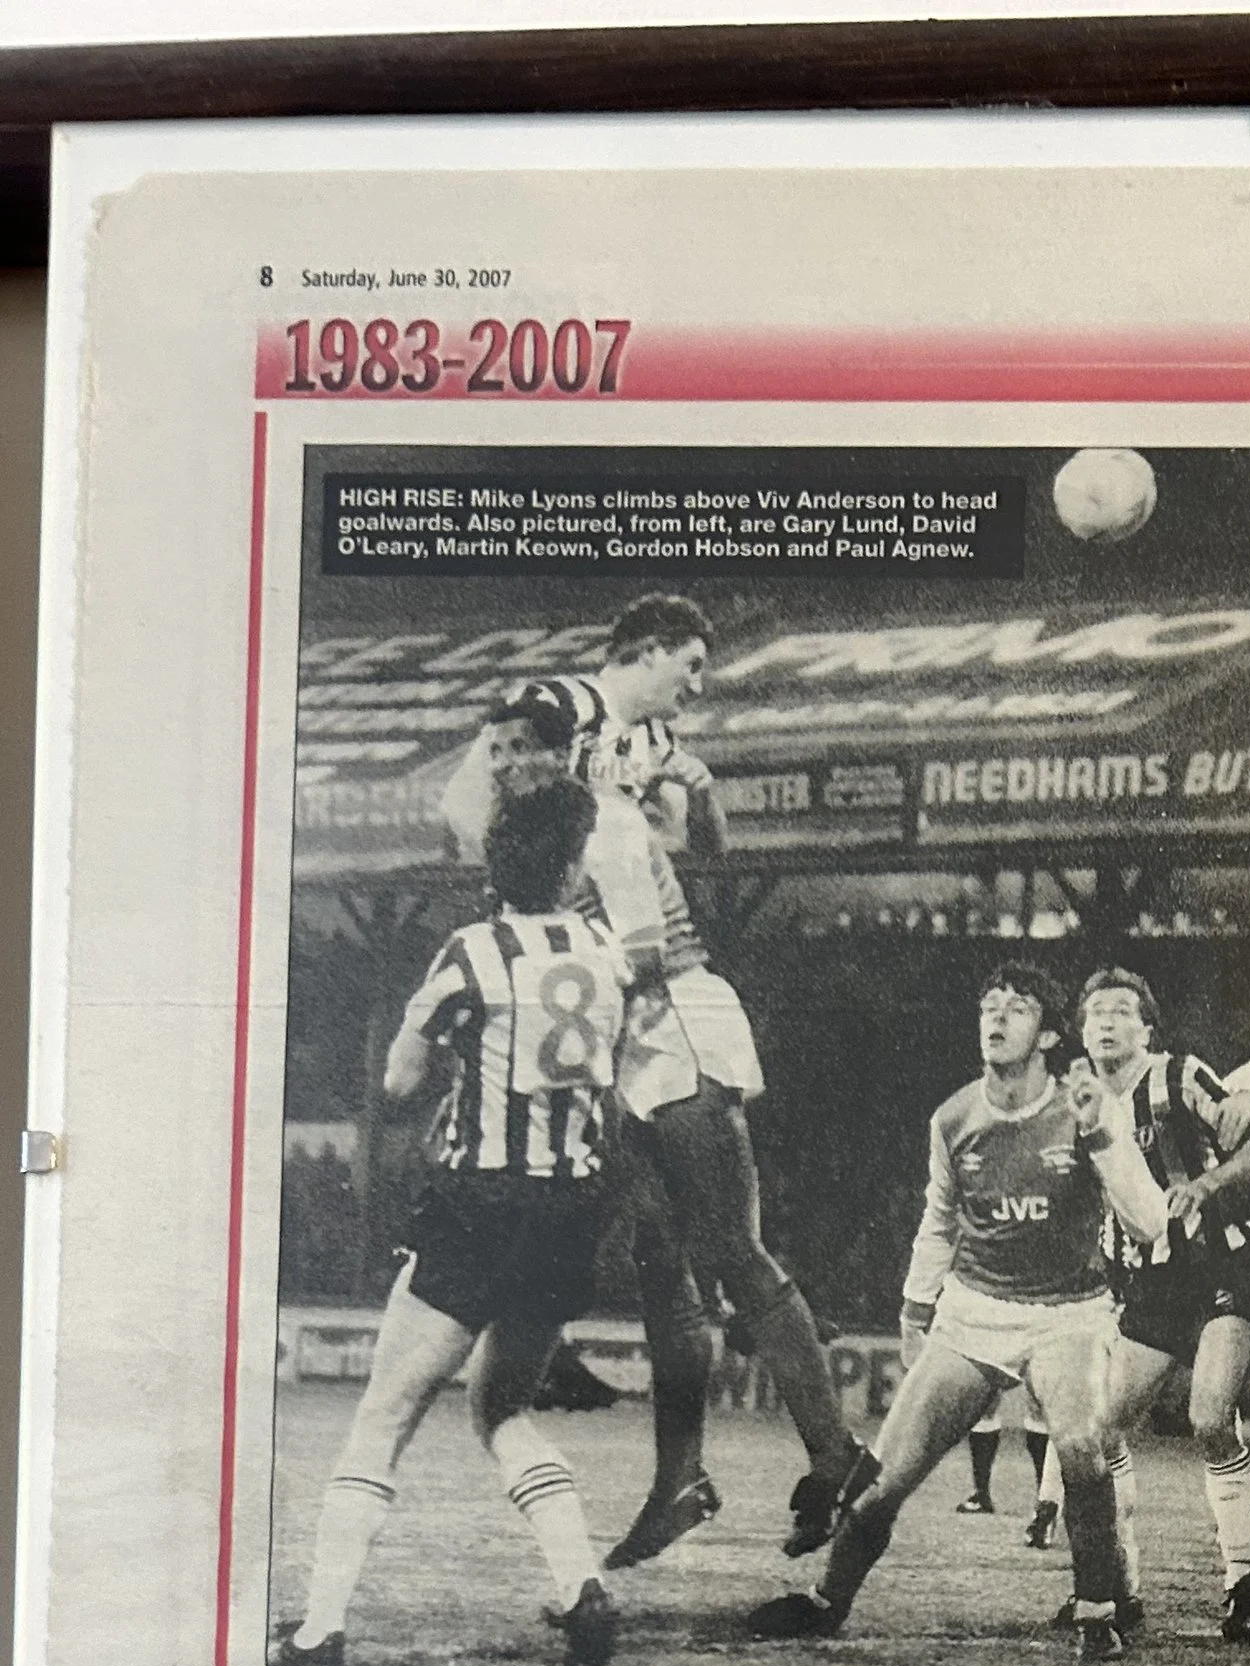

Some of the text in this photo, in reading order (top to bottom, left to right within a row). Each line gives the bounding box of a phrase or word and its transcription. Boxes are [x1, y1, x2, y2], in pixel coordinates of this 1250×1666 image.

[258, 264, 512, 292] 8 Saturday, June 30, 2007
[285, 319, 632, 393] 1983-2007
[338, 487, 997, 512] HIGH RISE: Mike Lyons climbs above Viv Anderson to head
[337, 511, 976, 537] goalwards. Also pictured, from left, are Gary Lund, David
[337, 535, 974, 562] O'Leary, Martin Keown, Gordon Hobson and Paul Agnew.
[921, 752, 1170, 802] NEEDHAMS
[537, 961, 597, 1082] 8
[991, 1195, 1050, 1222] JVC
